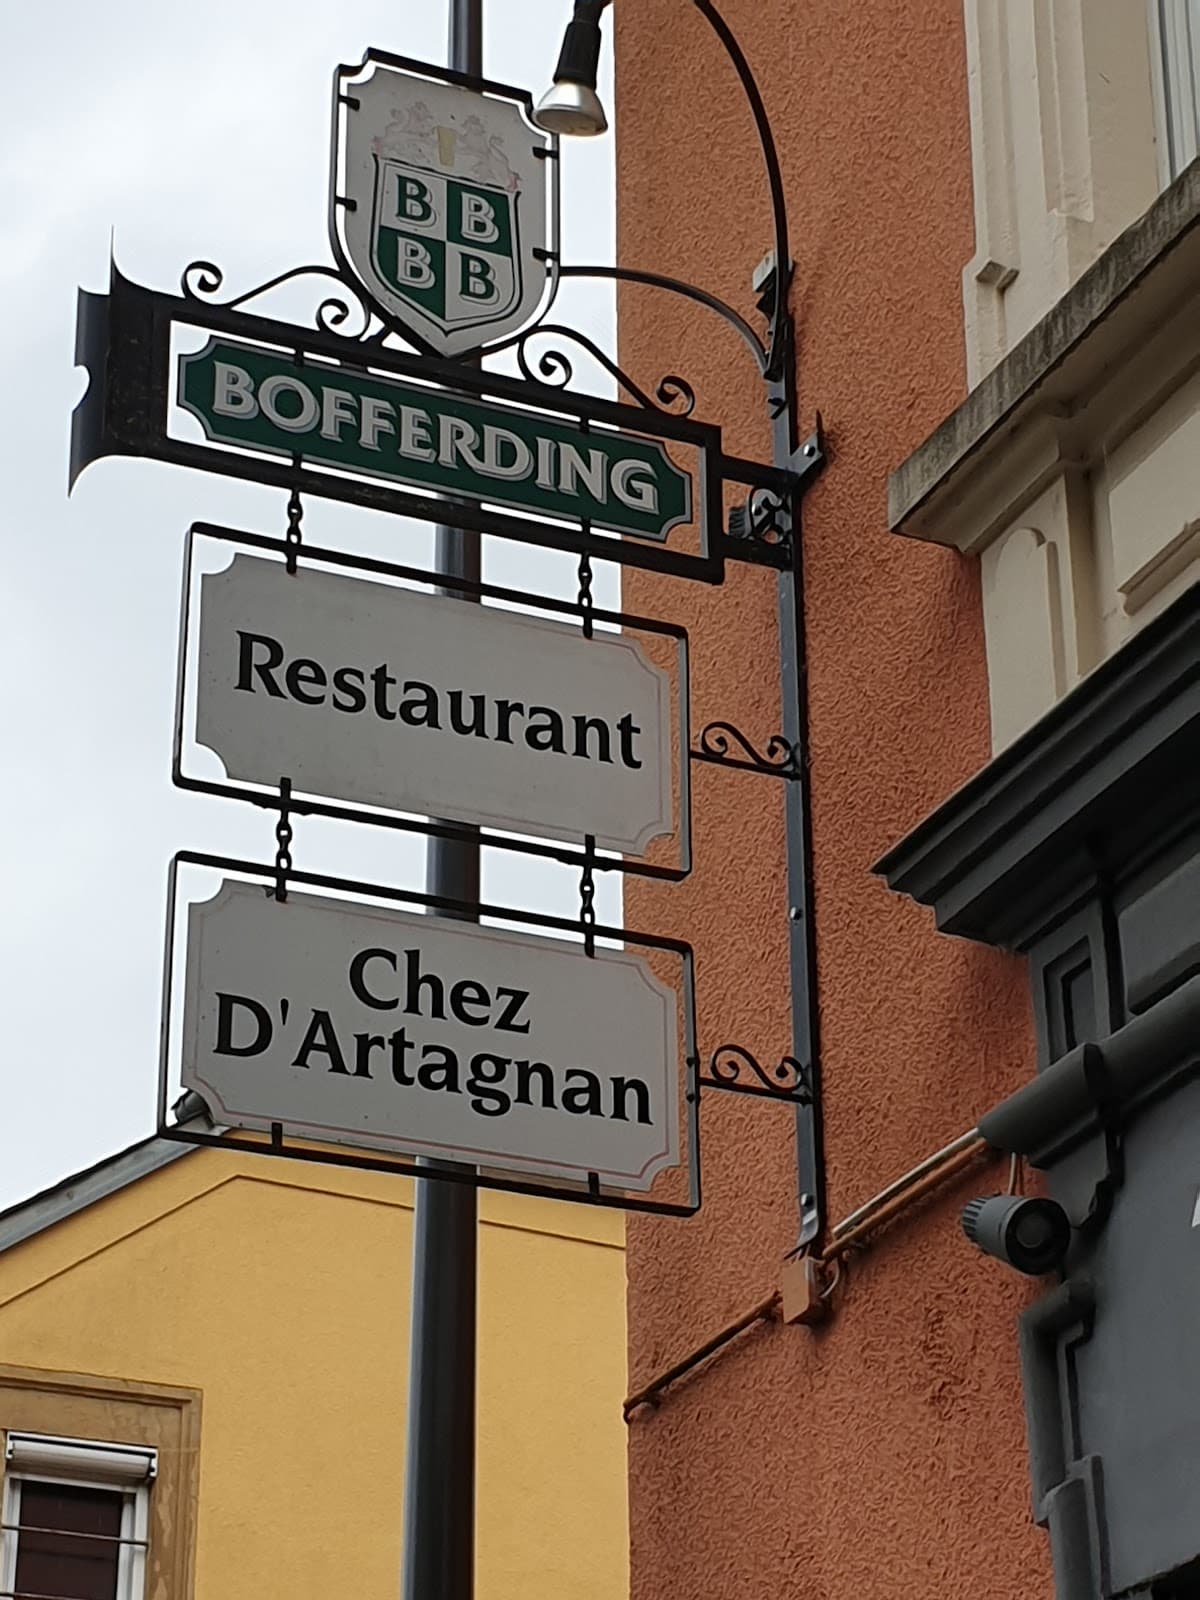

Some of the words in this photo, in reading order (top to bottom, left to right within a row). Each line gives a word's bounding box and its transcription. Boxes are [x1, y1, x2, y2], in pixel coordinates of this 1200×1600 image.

[396, 174, 436, 226] B
[461, 191, 500, 244] B
[397, 236, 436, 289] B
[459, 252, 499, 304] B
[212, 361, 659, 513] BOFFERDING
[235, 631, 642, 769] Restaurant
[349, 947, 533, 1034] Chez
[213, 992, 653, 1125] D'Artagnan
